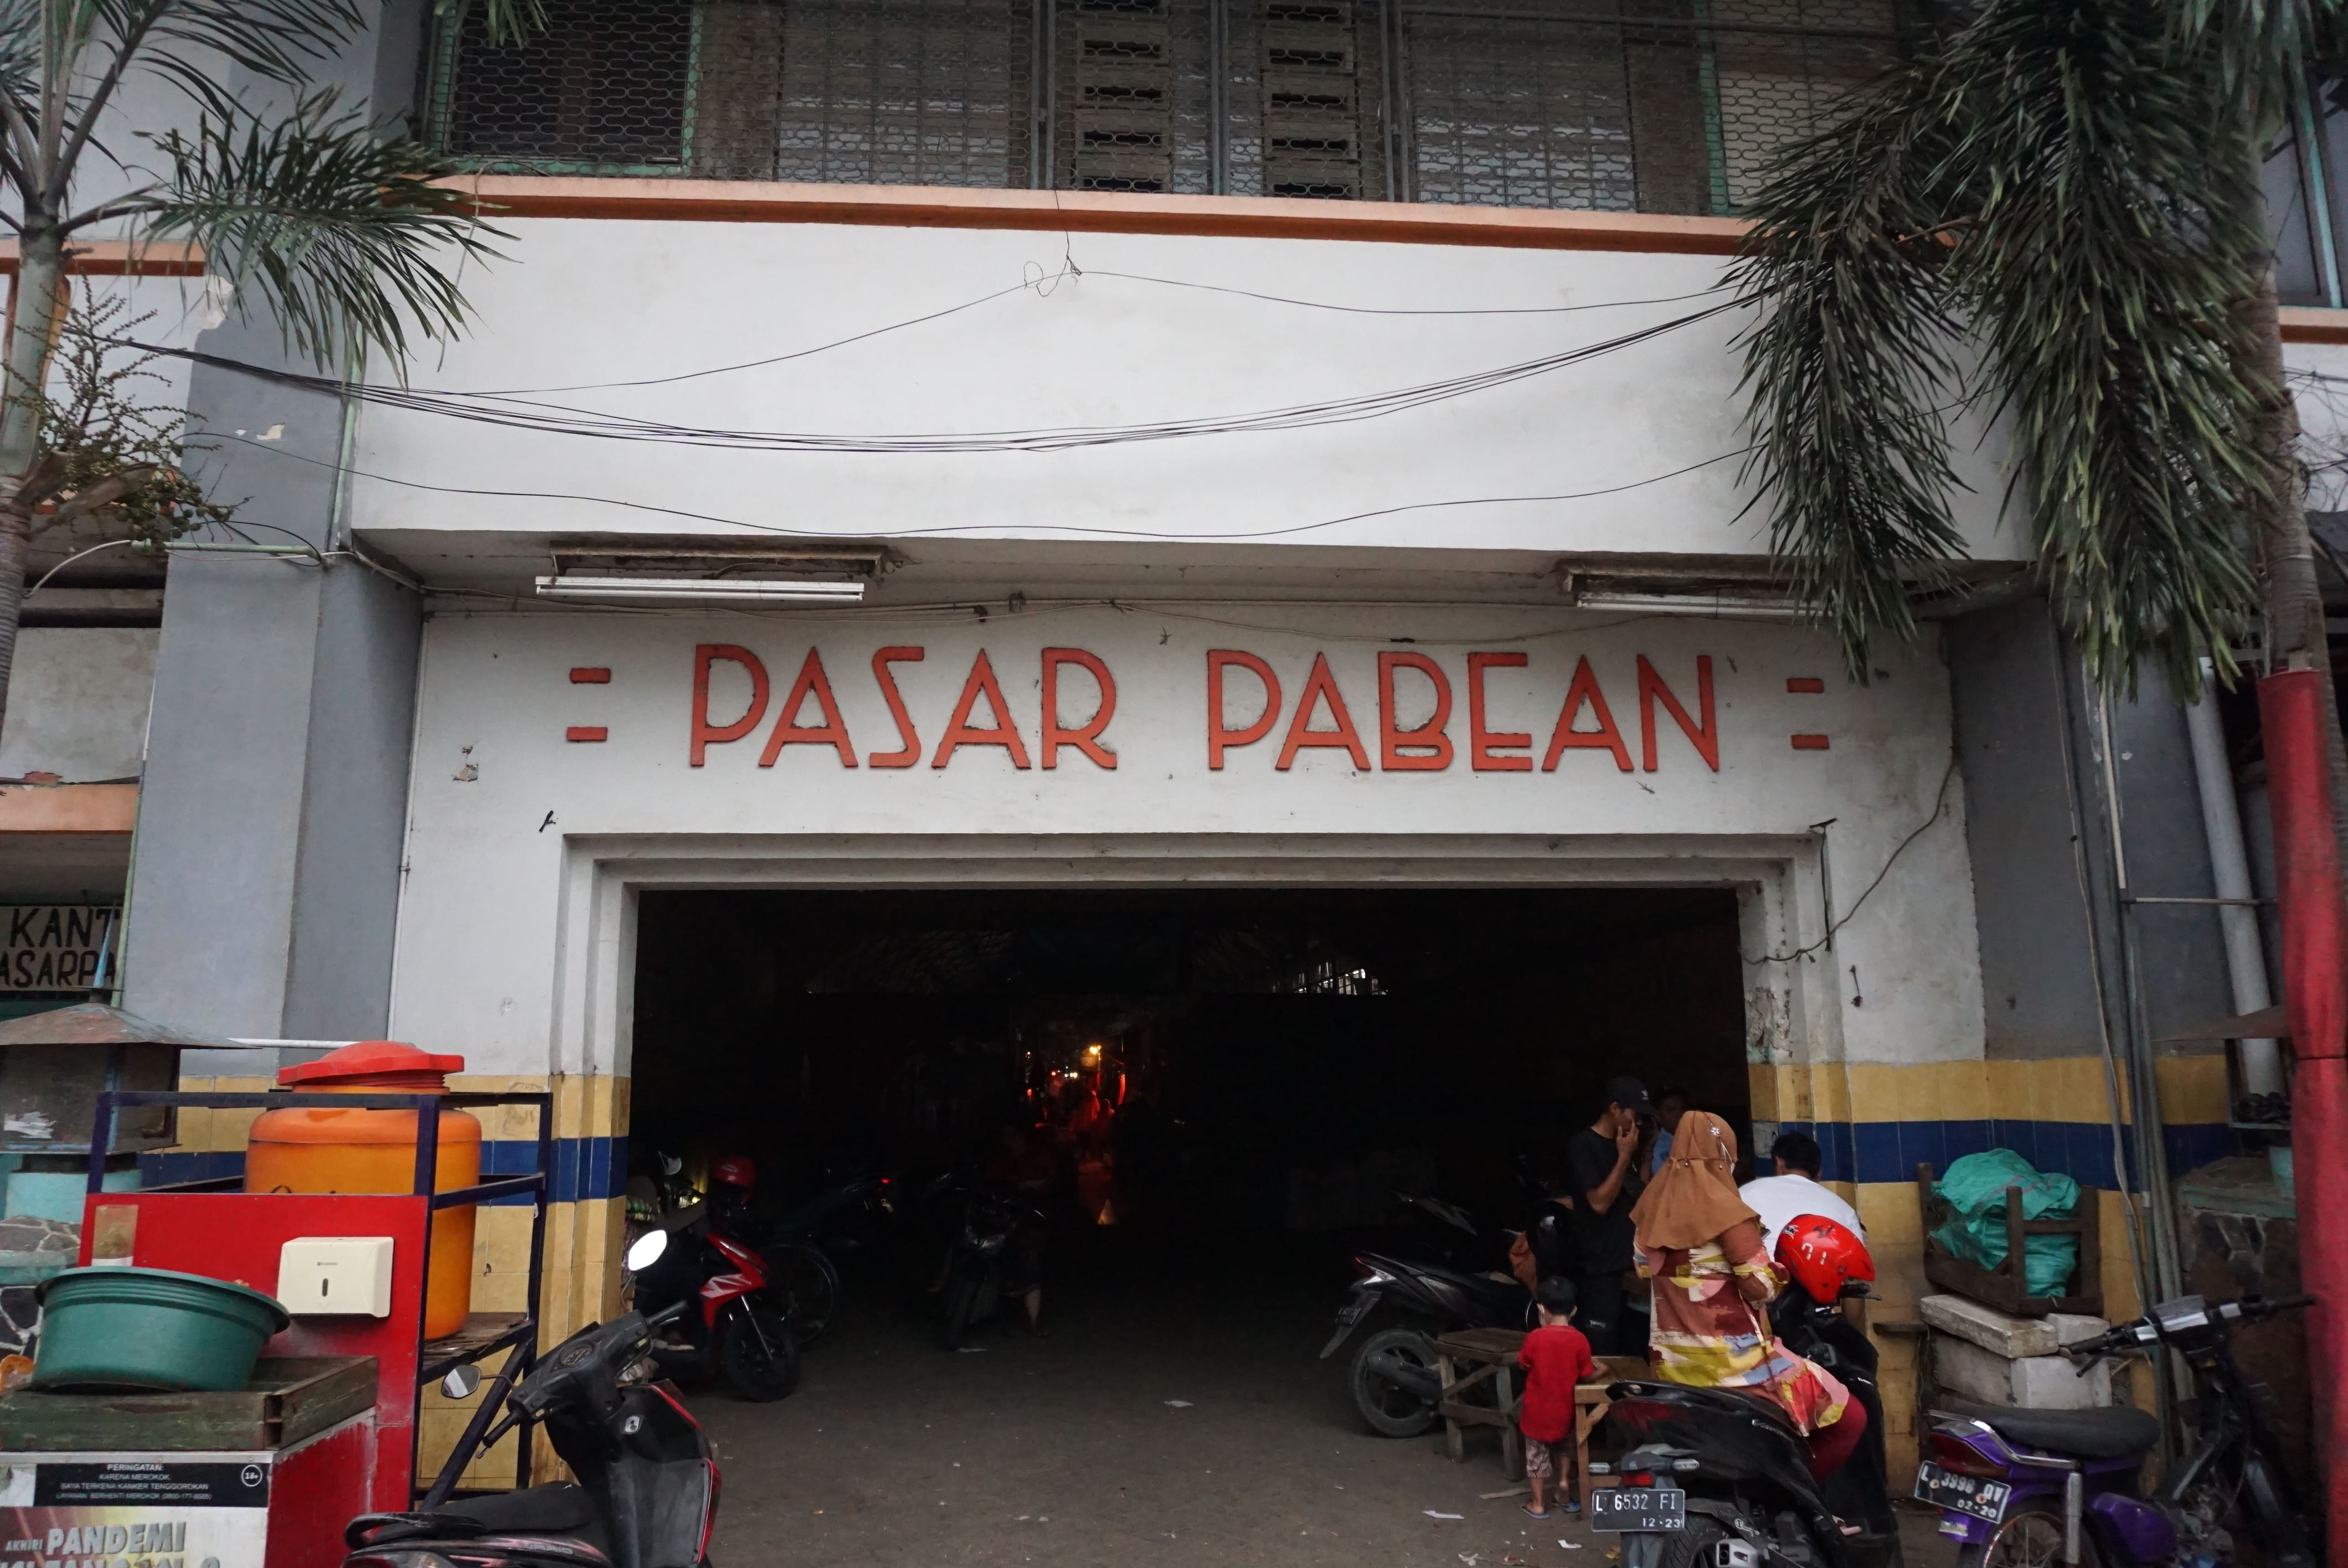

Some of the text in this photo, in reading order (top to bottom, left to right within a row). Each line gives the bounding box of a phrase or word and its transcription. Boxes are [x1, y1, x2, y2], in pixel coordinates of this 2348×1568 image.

[691, 643, 1719, 772] PASAR PABEAN
[1920, 1465, 1929, 1482] L
[1595, 1493, 1676, 1512] L 6532 FI
[6, 1521, 187, 1556] AKHIRI PANDEMI
